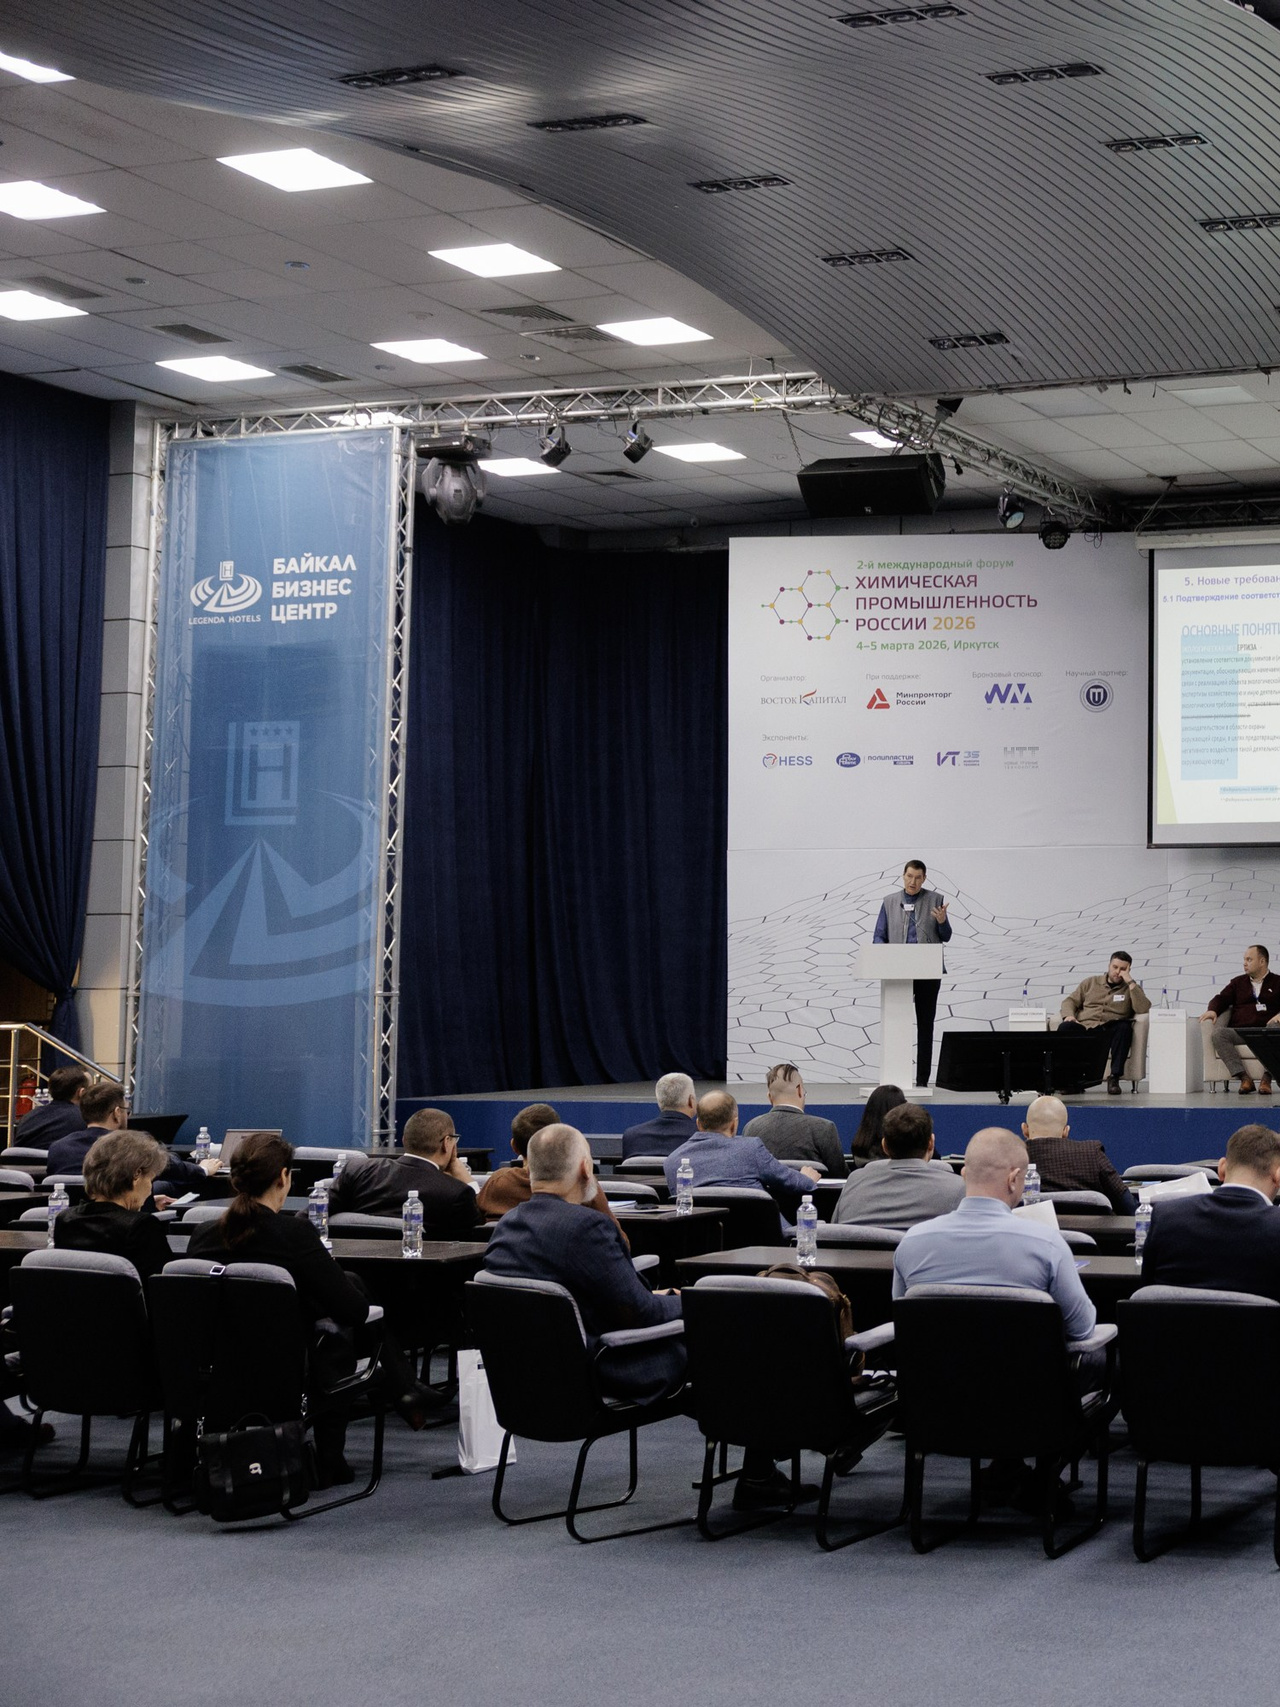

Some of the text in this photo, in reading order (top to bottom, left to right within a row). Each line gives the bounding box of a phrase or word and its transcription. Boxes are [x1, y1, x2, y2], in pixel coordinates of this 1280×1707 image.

[273, 553, 356, 574] БАЙКАЛ
[857, 558, 1014, 571] 2-й международный форум
[855, 575, 978, 589] ХИМИЧЕСКАЯ
[1184, 576, 1194, 586] 5.
[1197, 576, 1230, 585] Новые
[272, 578, 352, 598] БИЗНЕС
[856, 594, 1038, 610] ПРОМЫШЛЕННОСТЬ
[1163, 595, 1174, 603] 5.1
[1176, 593, 1239, 603] Подтверждение
[271, 602, 338, 624] ЦЕНТР
[188, 614, 261, 625] LEGENDA HOTELS
[856, 616, 976, 631] РОССИИ 2026
[1182, 623, 1239, 637] ОСНОВНЫЕ
[880, 641, 914, 652] марта
[918, 640, 950, 651] 2026,
[953, 640, 999, 651] Иркутск
[760, 675, 807, 683] Организатор:
[866, 673, 921, 681] При поддержке:
[972, 671, 1043, 679] Бронзовый спонсор:
[1065, 670, 1096, 678] Научный
[760, 689, 847, 706] ВОСТОК КАПИТАЛ
[896, 691, 952, 700] Минпромторг
[762, 734, 809, 742] Экспоненты:
[779, 755, 813, 766] HESS
